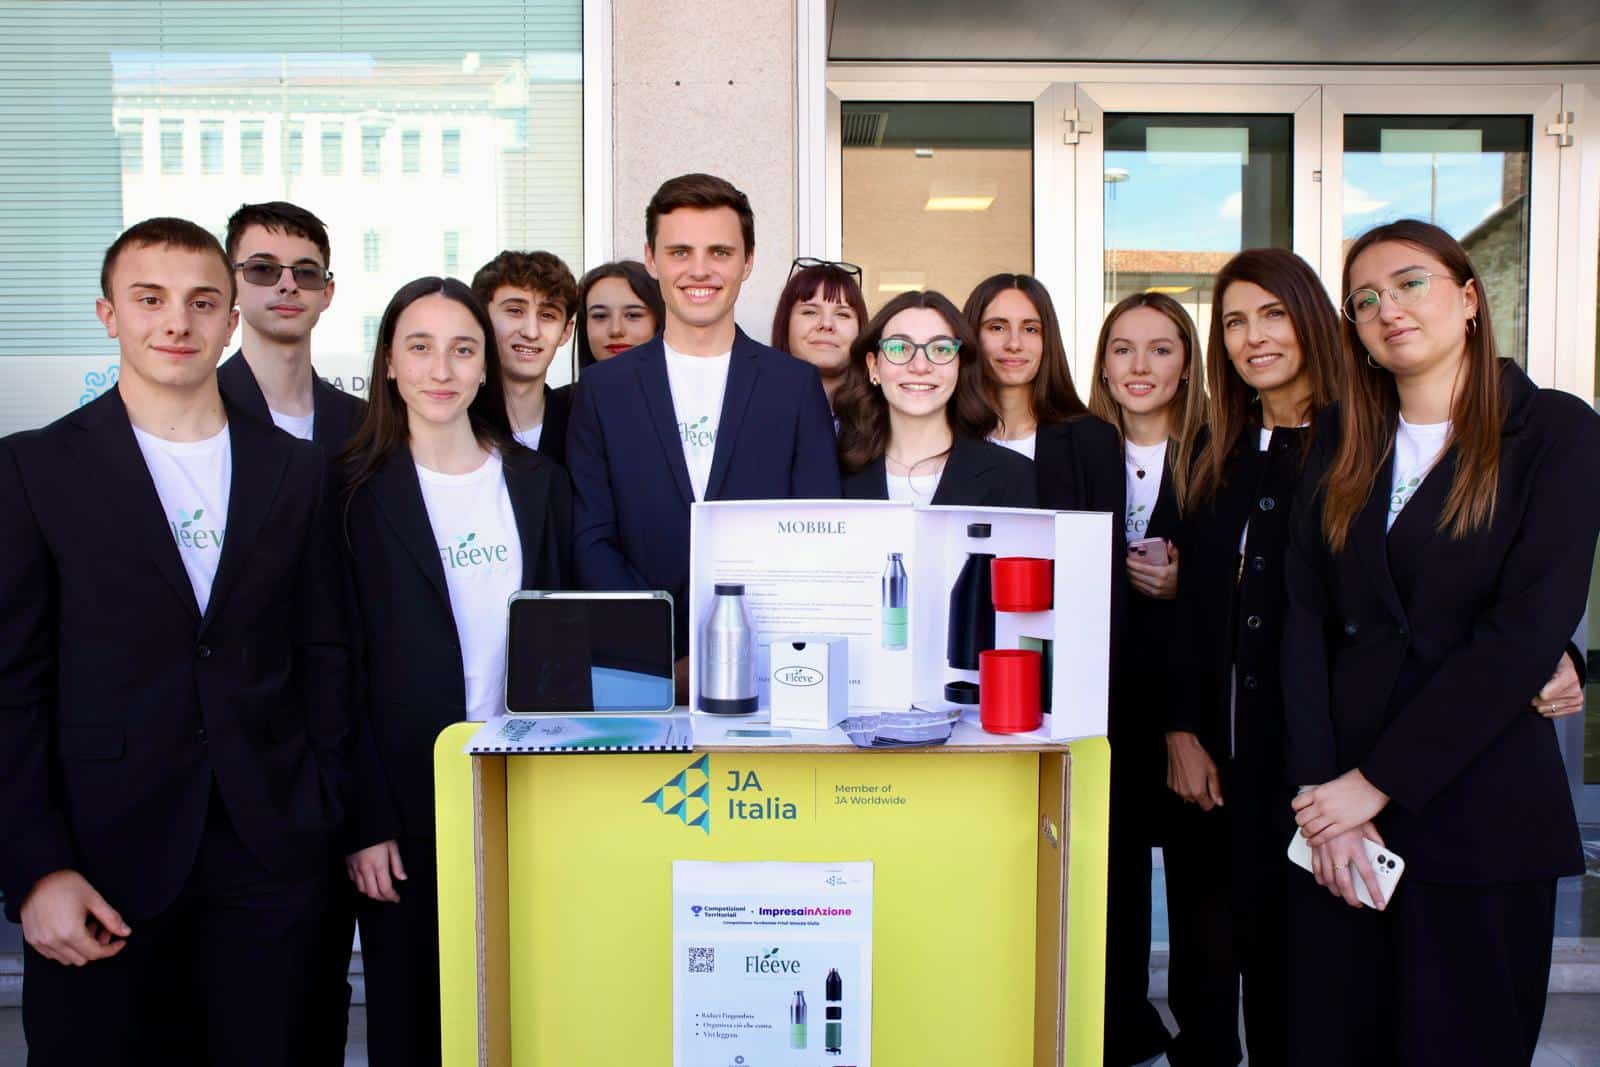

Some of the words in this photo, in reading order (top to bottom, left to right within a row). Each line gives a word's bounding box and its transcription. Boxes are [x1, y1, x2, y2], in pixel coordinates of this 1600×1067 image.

[777, 520, 847, 534] MOBBLE
[785, 672, 814, 683] Fleeve
[727, 770, 763, 791] JA
[835, 784, 879, 793] Member
[881, 784, 892, 793] of
[834, 796, 848, 805] JA
[850, 796, 907, 805] Worldwide
[729, 797, 797, 819] Italia
[759, 906, 852, 918] ImpresainAzione
[745, 955, 801, 974] Fleeve
